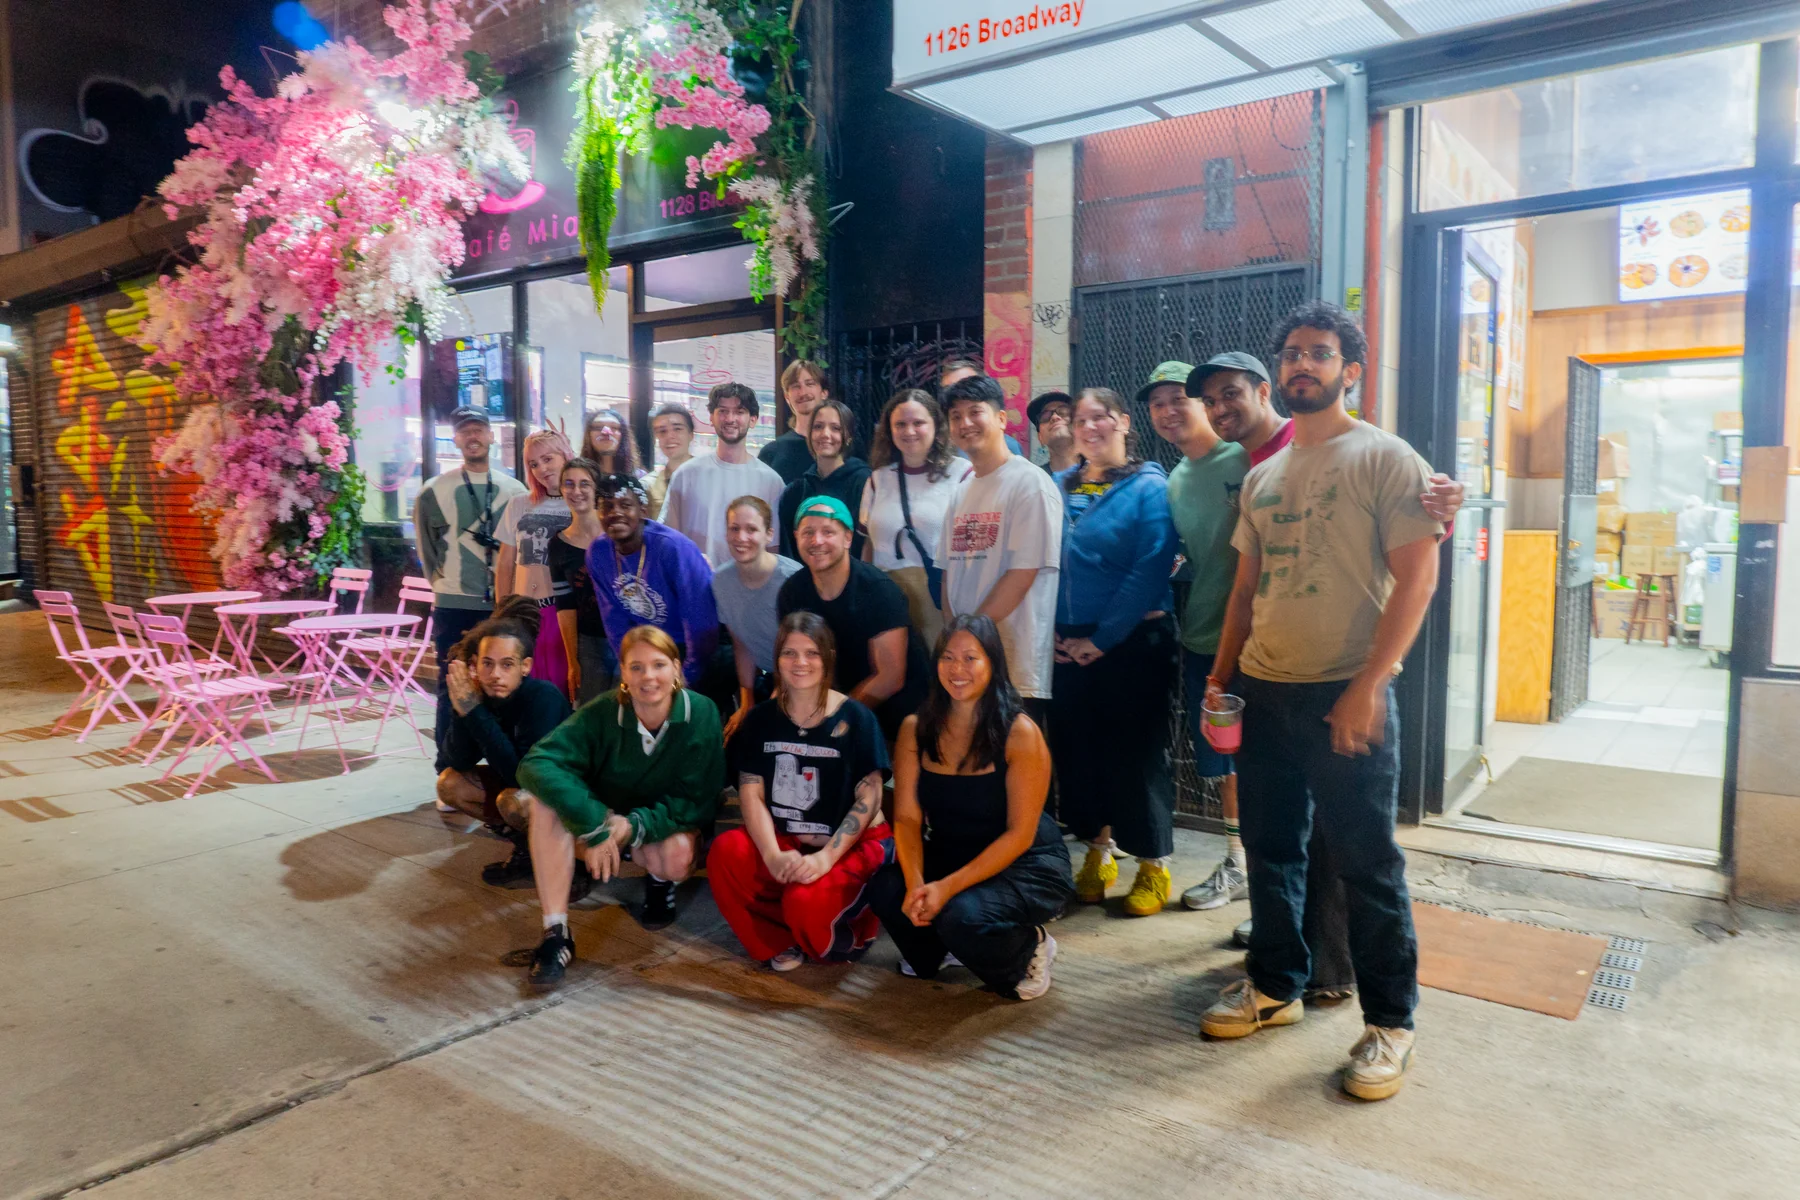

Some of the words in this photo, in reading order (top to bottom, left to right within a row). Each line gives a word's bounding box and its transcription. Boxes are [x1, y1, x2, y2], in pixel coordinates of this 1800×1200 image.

[924, 23, 970, 57] 1126
[978, 0, 1085, 43] Broadway
[659, 194, 695, 219] 1128
[469, 225, 512, 258] afé
[528, 214, 579, 245] Mia
